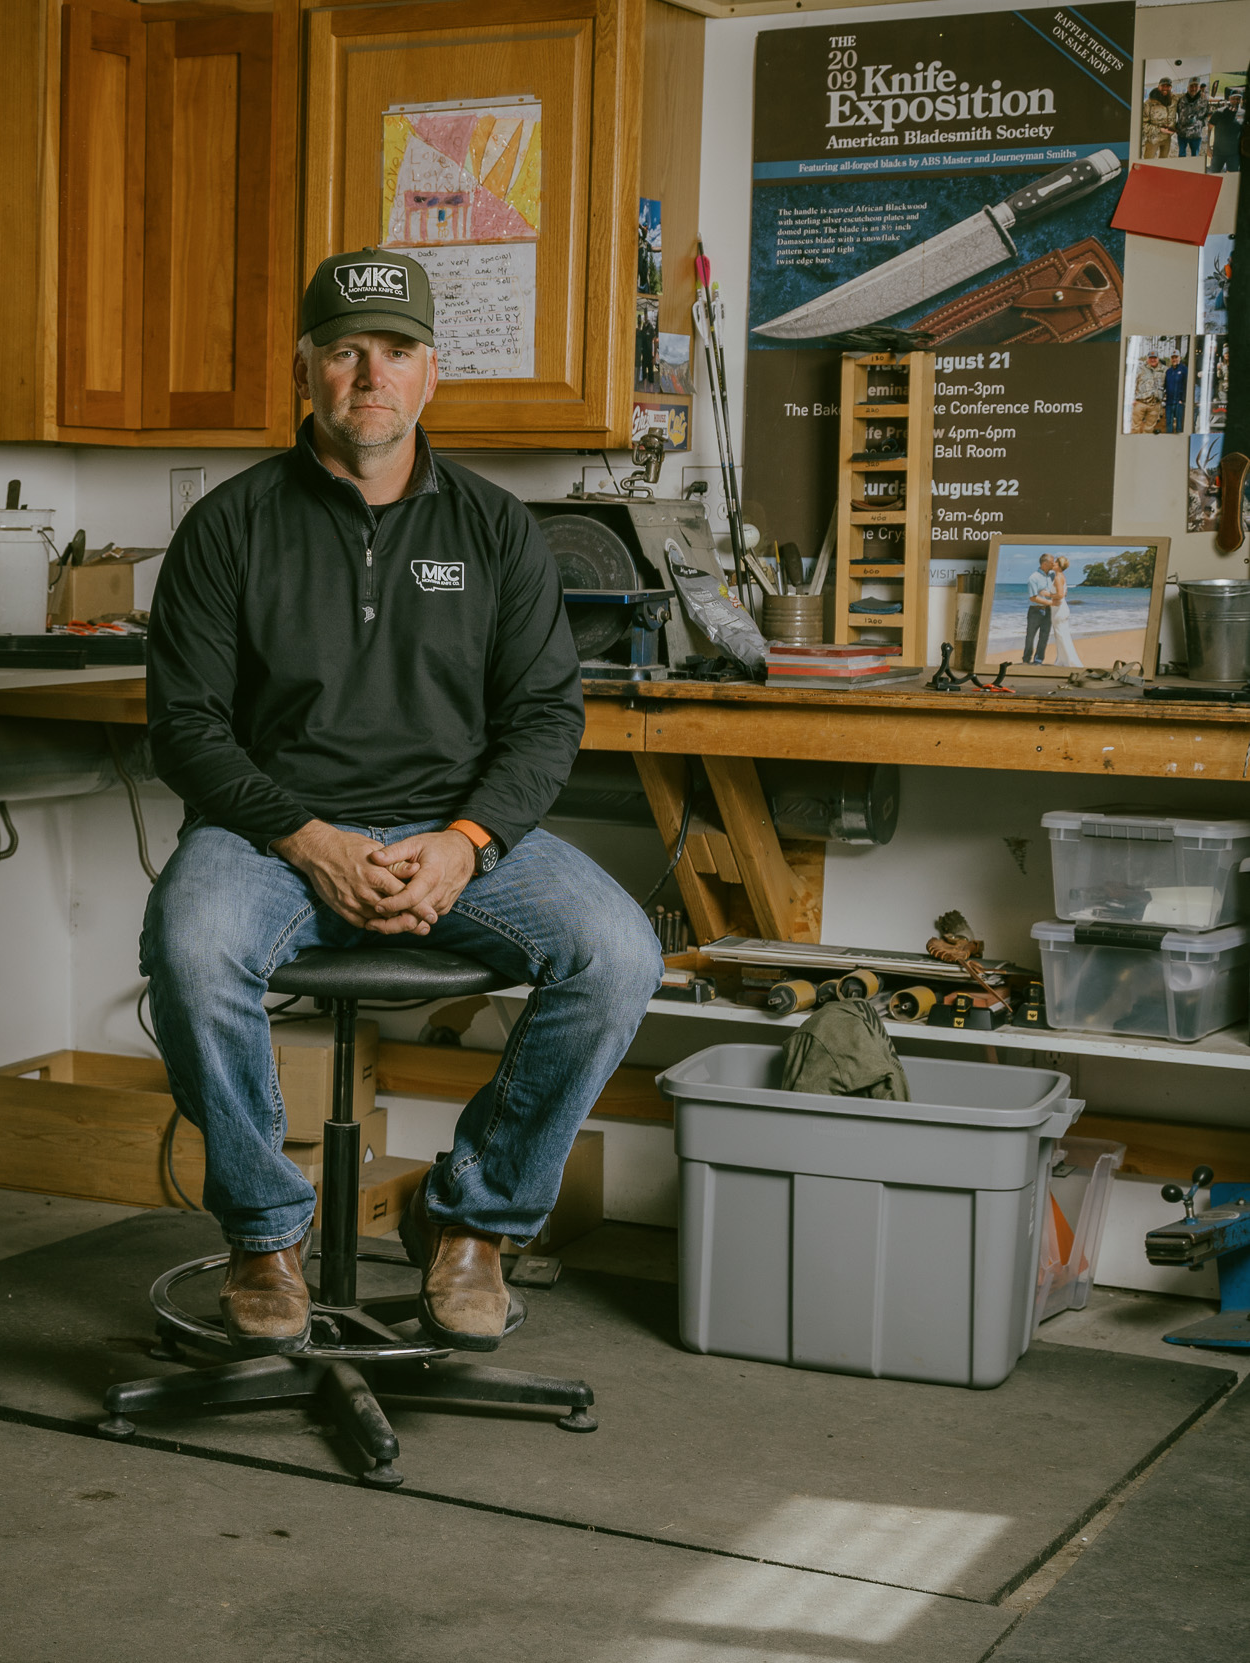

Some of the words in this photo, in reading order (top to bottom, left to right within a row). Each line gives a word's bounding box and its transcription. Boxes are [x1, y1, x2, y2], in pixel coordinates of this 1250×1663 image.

[829, 36, 856, 48] THE
[1054, 12, 1088, 42] RAFFLE
[1087, 38, 1124, 70] TICKETS
[1052, 26, 1068, 40] ON
[1065, 37, 1090, 58] SALE
[1087, 54, 1110, 74] NOW
[828, 50, 858, 70] 20
[827, 70, 858, 90] 09
[860, 60, 956, 97] Knife
[826, 80, 1056, 132] Exposition
[826, 133, 899, 149] American
[904, 126, 992, 144] Bladesmith
[996, 123, 1054, 140] Society
[799, 162, 838, 173] Featuring
[840, 160, 878, 170] all-forged
[880, 158, 906, 168] blades
[909, 158, 920, 168] by
[920, 156, 940, 166] ABS
[943, 155, 972, 165] Master
[974, 154, 990, 164] and
[992, 152, 1044, 164] Journeyman
[1046, 150, 1077, 159] Smiths
[794, 207, 818, 216] handle
[828, 206, 854, 214] carved
[856, 204, 884, 213] African
[886, 202, 928, 211] Blackwood
[778, 218, 794, 226] with
[794, 216, 820, 226] sterling
[822, 216, 842, 224] silver
[884, 214, 904, 224] plates
[906, 212, 919, 220] and
[778, 228, 802, 236] domed
[840, 224, 860, 233] blade
[777, 237, 814, 246] Damascus
[816, 236, 836, 244] blade
[838, 235, 854, 243] with
[862, 234, 900, 242] snowflake
[776, 247, 802, 256] pattern
[822, 246, 836, 254] and
[837, 245, 854, 255] tight
[796, 257, 814, 266] edge
[348, 267, 403, 290] MKC
[934, 353, 984, 373] ugust
[988, 352, 1010, 368] 21
[784, 404, 809, 416] The
[950, 401, 1030, 414] Conference
[1034, 400, 1083, 414] Rooms
[948, 425, 1016, 442] 4pm-6pm
[934, 444, 962, 458] Ball
[966, 444, 1006, 458] Room
[996, 480, 1020, 496] 22
[938, 508, 1004, 524] 9am-6pm
[932, 528, 958, 541] Ball
[422, 564, 460, 582] MKC
[930, 569, 956, 580] VISIT
